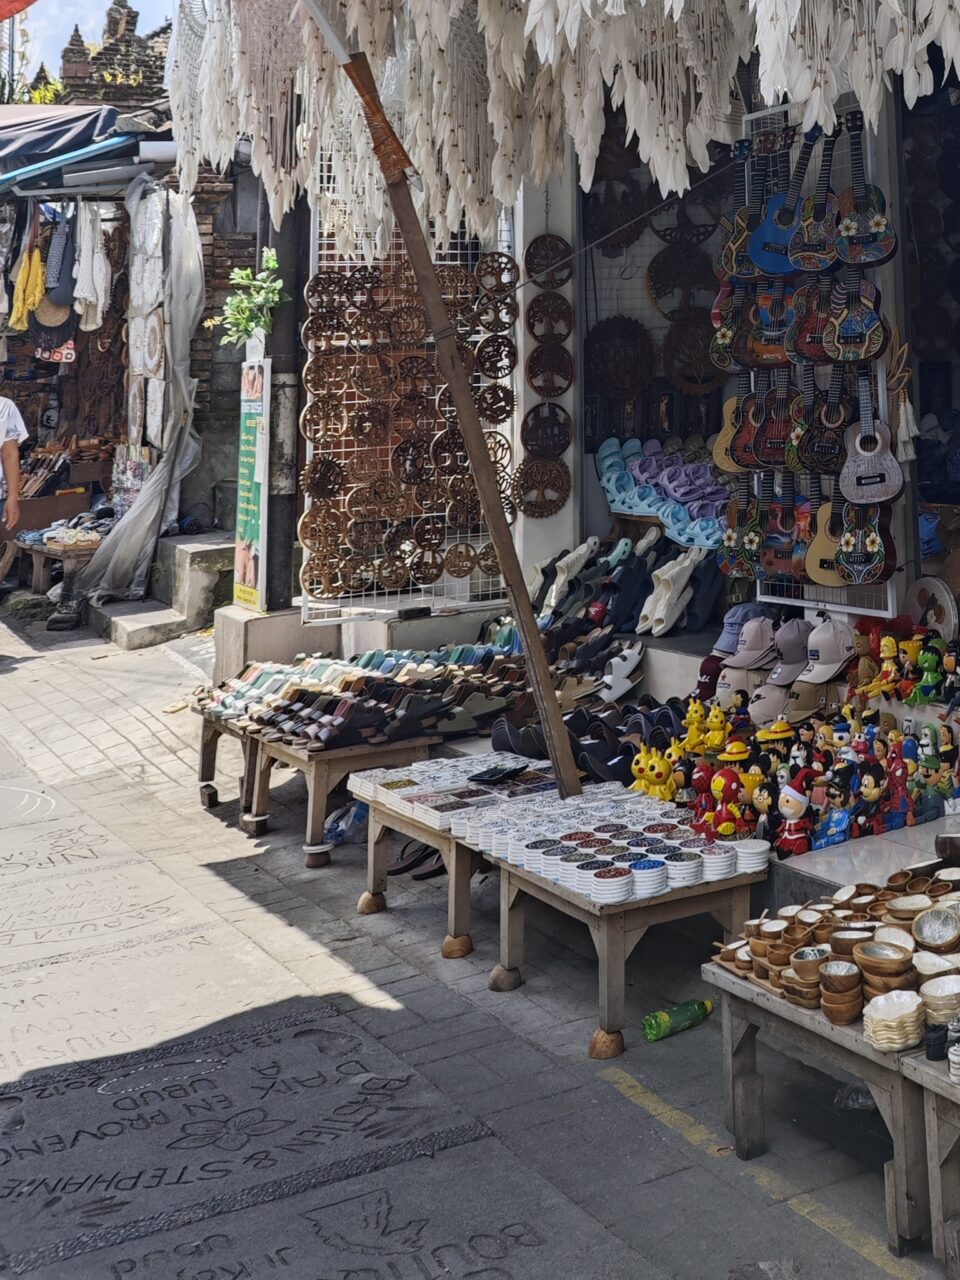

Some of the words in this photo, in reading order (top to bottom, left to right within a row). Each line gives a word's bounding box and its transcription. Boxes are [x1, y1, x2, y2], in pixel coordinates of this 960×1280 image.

[112, 1077, 216, 1112] UBUD
[183, 1093, 234, 1118] EN
[275, 1074, 418, 1153] BASTIEN
